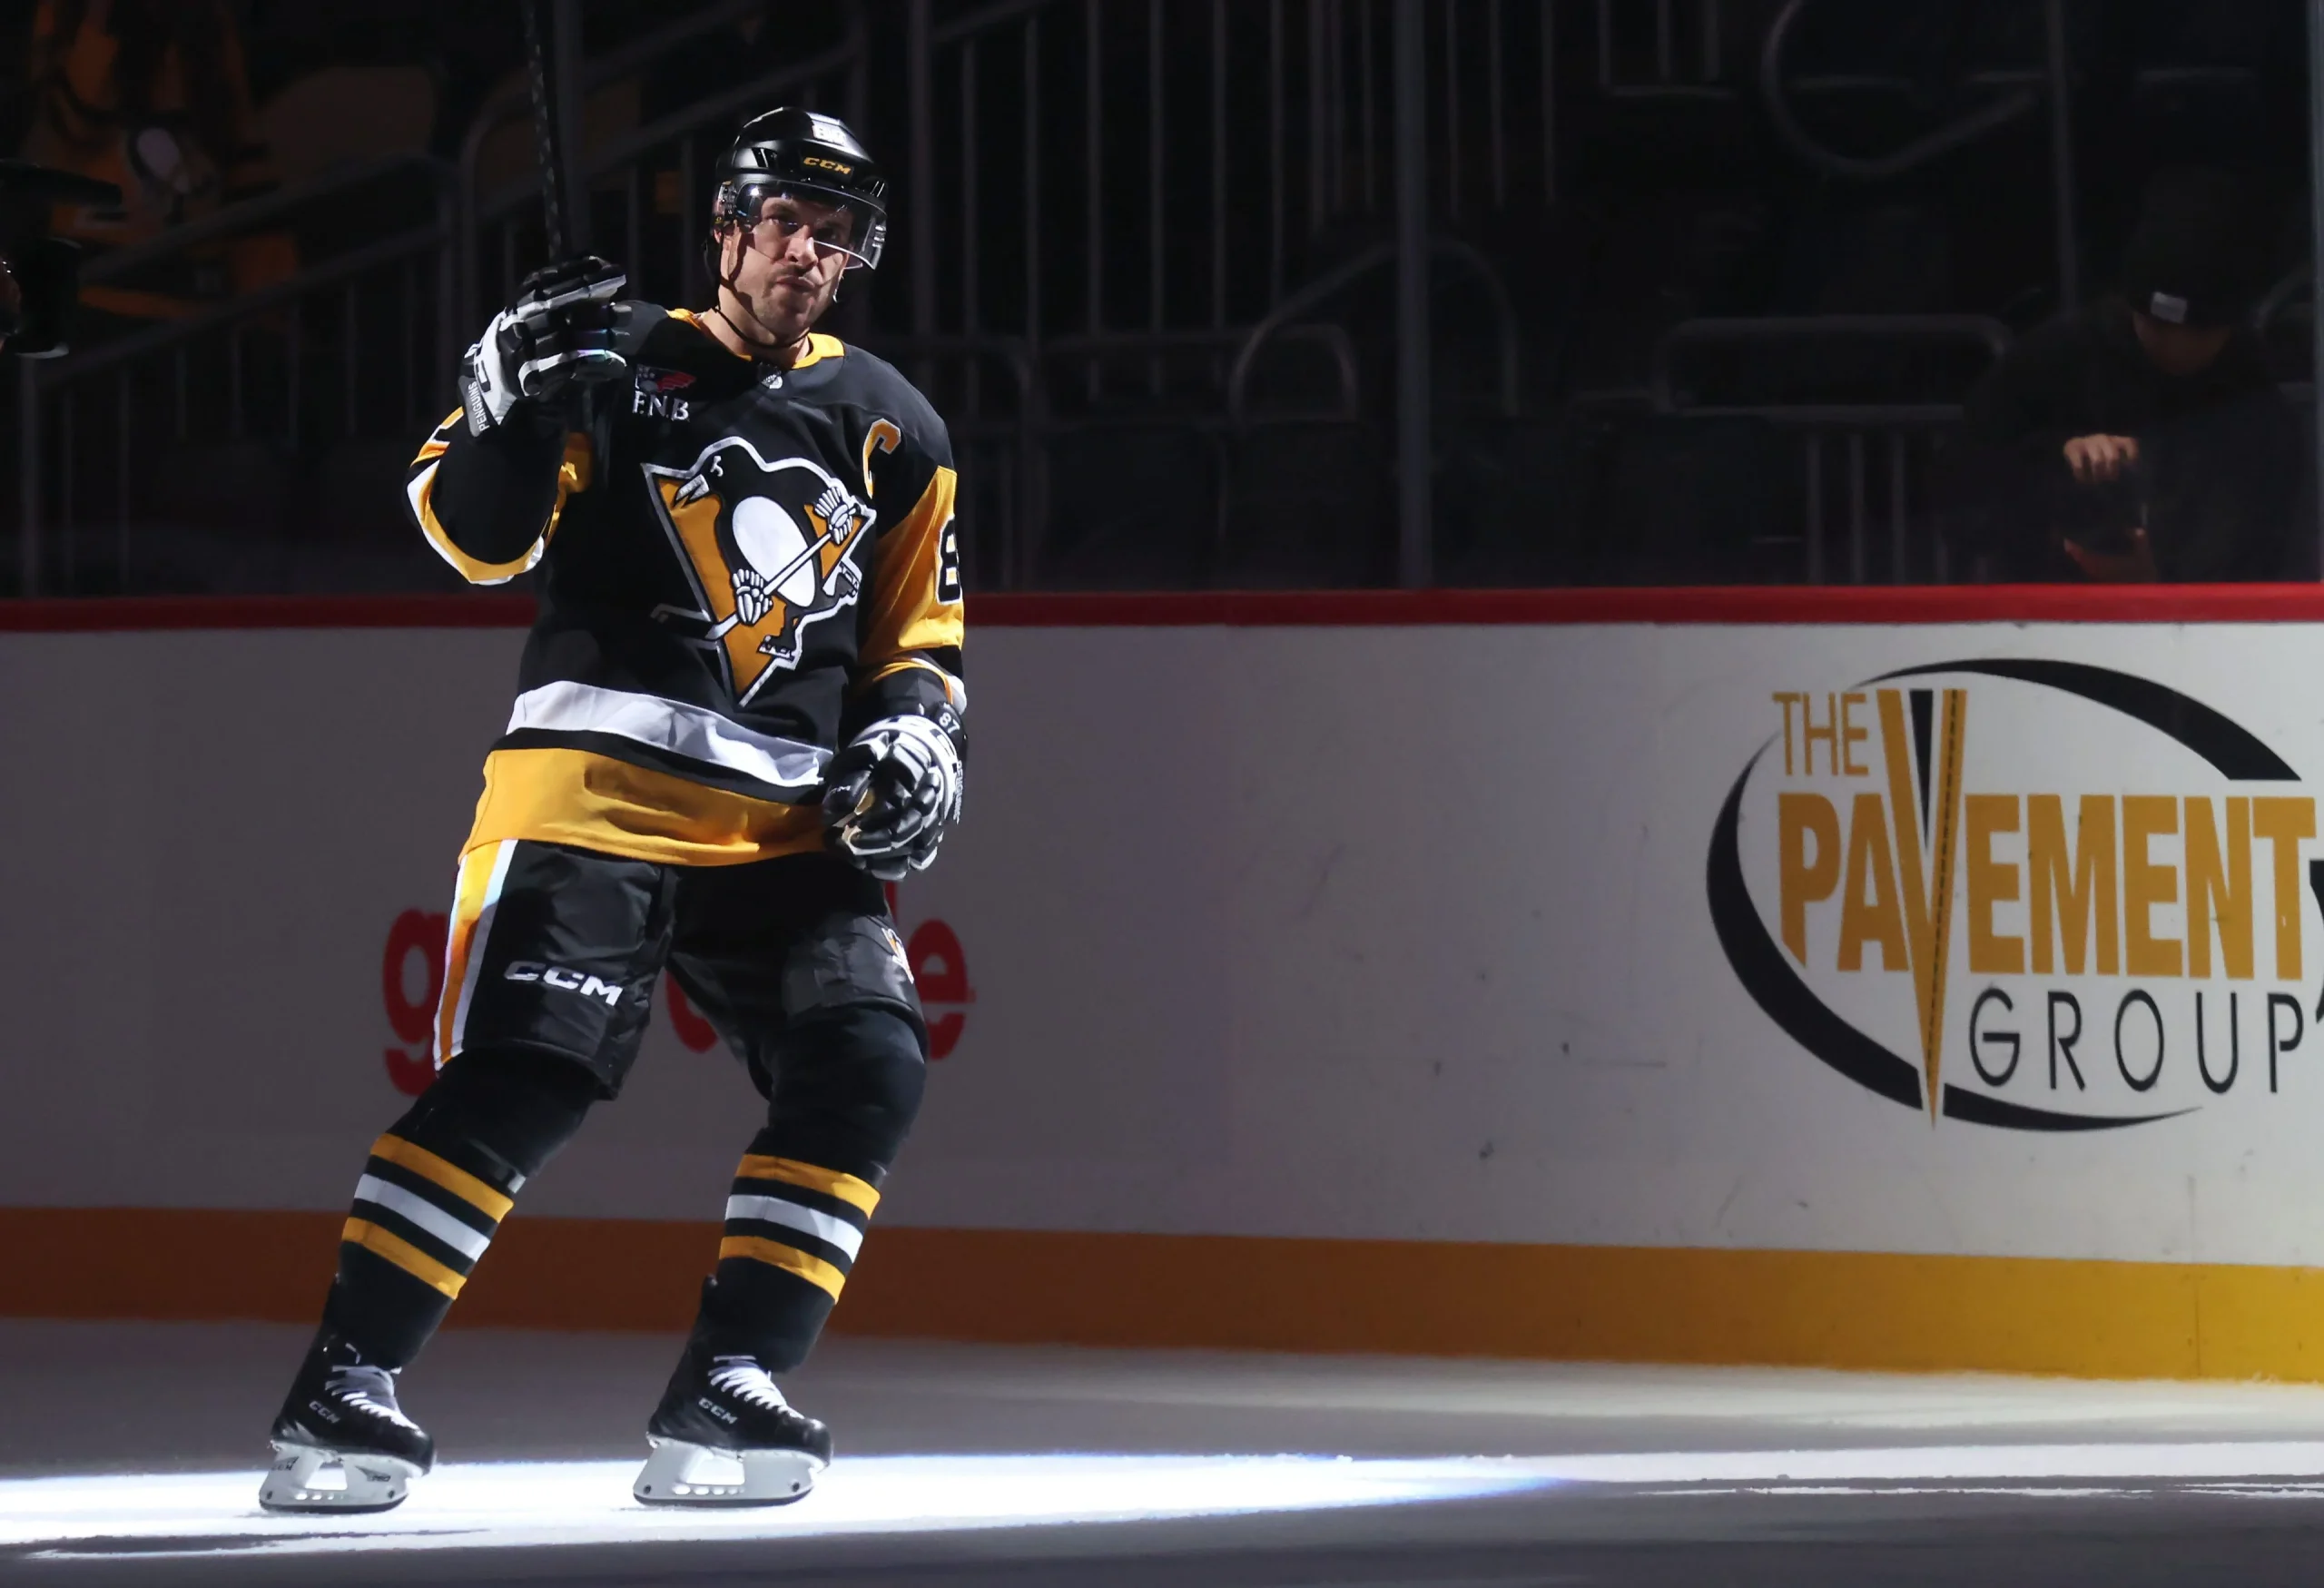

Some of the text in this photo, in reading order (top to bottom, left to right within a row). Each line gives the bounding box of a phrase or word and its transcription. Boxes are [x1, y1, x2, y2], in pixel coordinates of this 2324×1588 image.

[803, 157, 851, 174] CCM
[468, 382, 490, 431] PENGUINS
[863, 418, 901, 499] C
[939, 712, 960, 734] 87
[1772, 691, 1868, 776] THE
[1777, 688, 2317, 1129] PAVEMENT
[504, 961, 624, 1006] CCM
[1969, 988, 2304, 1094] GROUP
[309, 1401, 341, 1424] CCM
[699, 1397, 738, 1425] CCM
